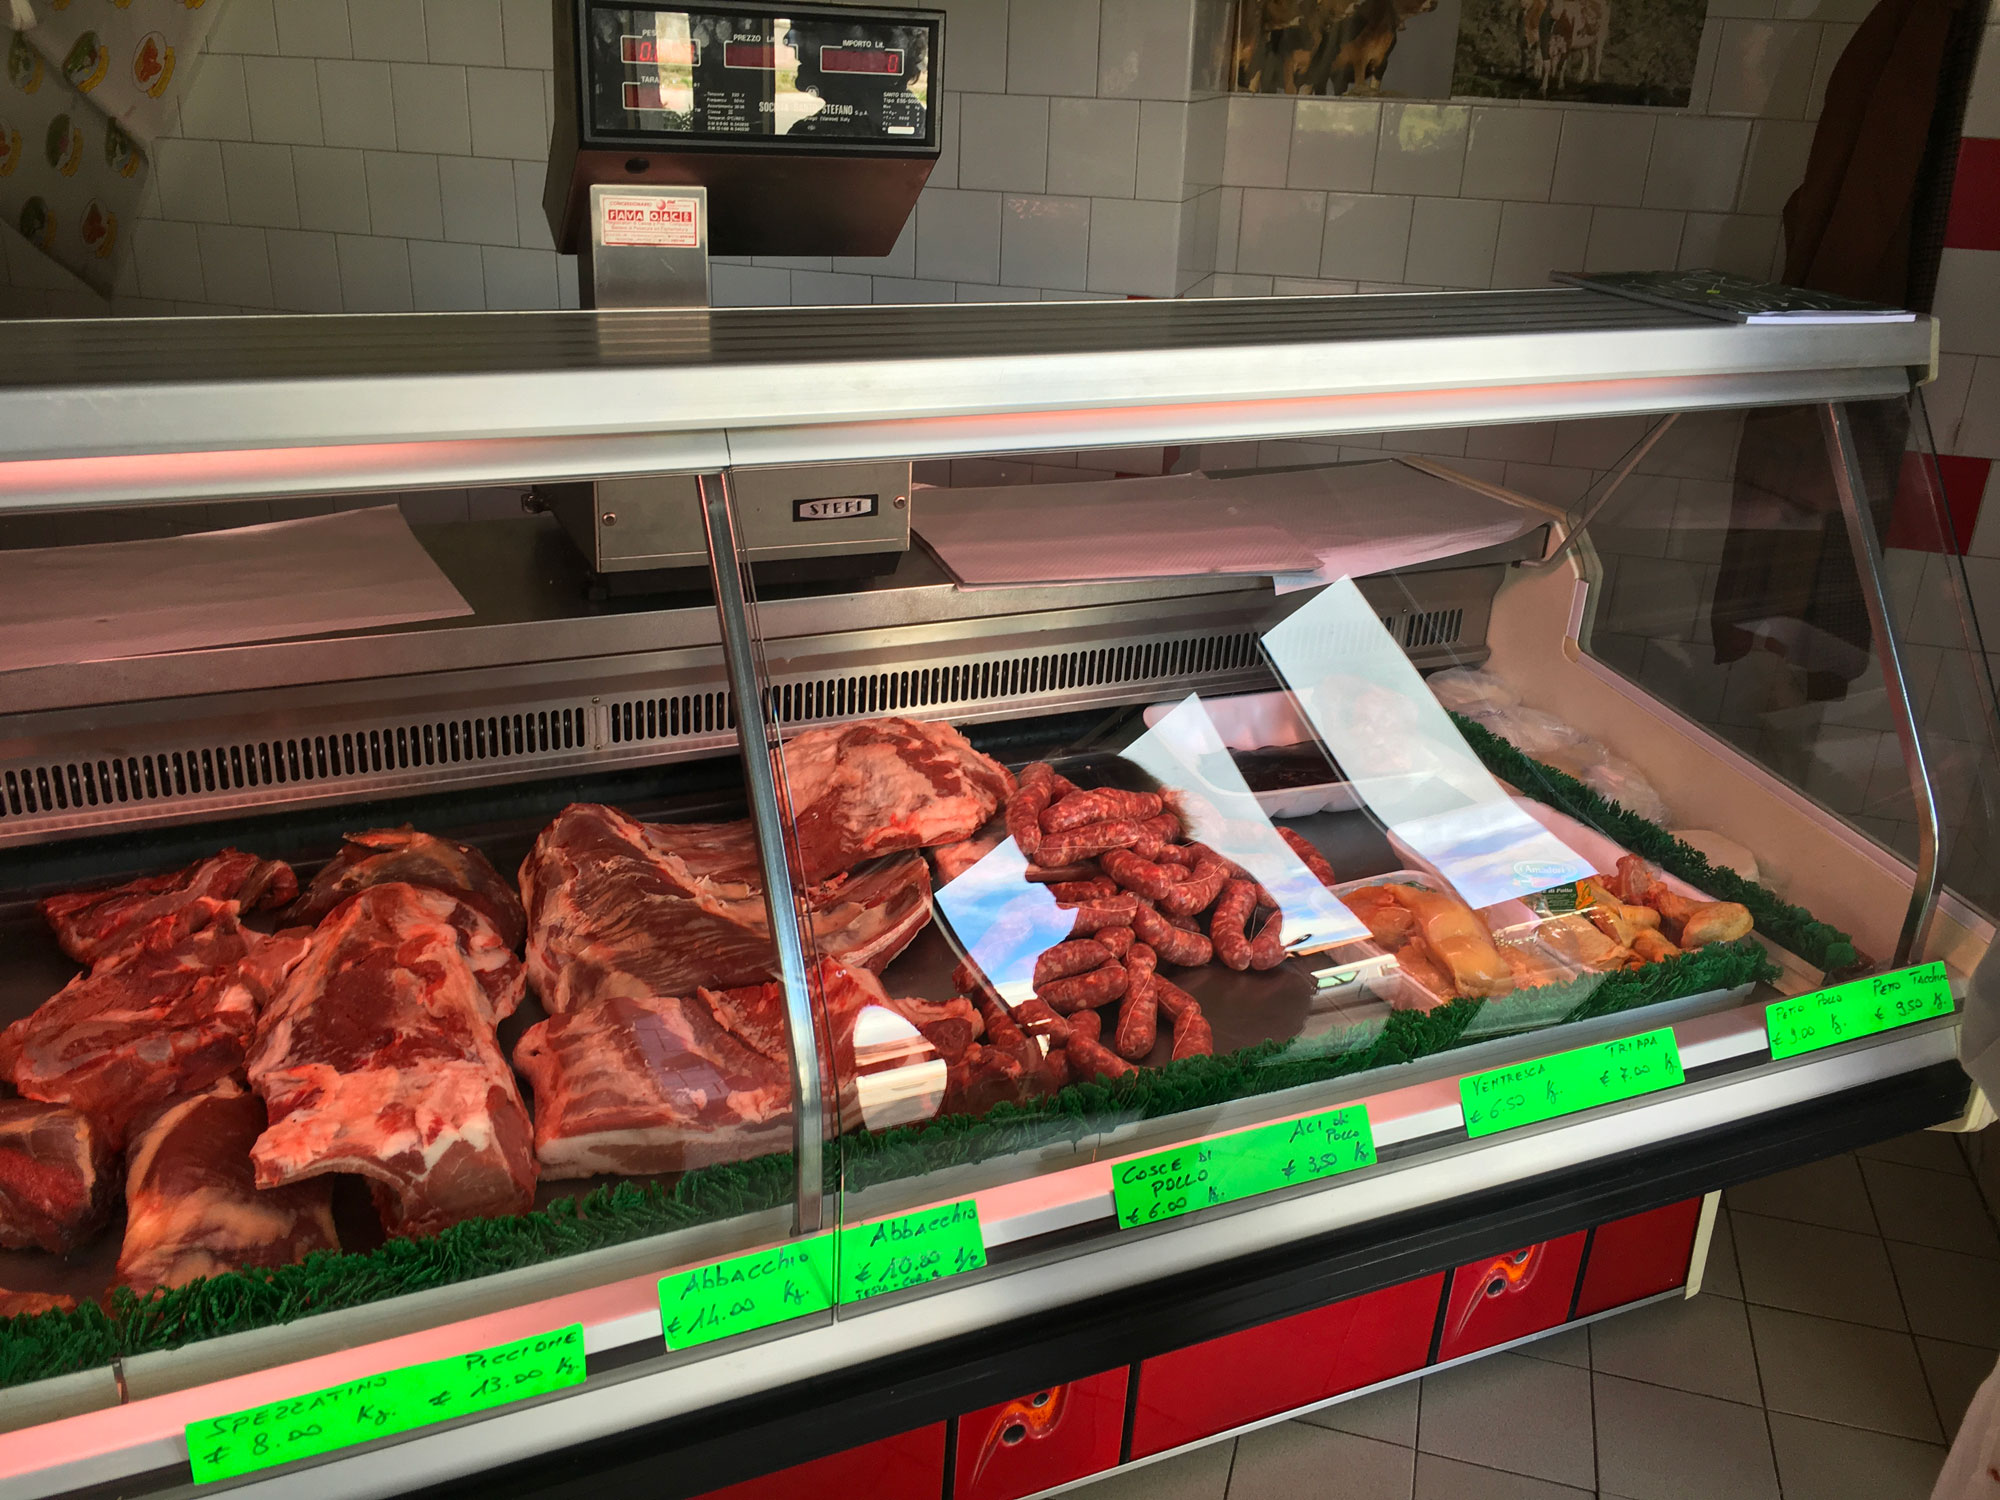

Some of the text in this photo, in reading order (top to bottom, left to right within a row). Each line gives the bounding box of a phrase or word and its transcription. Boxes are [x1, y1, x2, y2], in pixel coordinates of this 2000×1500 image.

[733, 34, 762, 42] PREZZO
[842, 39, 872, 48] IMPORTO
[887, 53, 899, 73] 0
[641, 75, 660, 84] TARA
[821, 104, 853, 116] STEFANO
[608, 209, 644, 221] FAVA
[1605, 1036, 1658, 1057] TRIPPA
[1472, 1063, 1546, 1096] VENTRESCA
[1599, 1070, 1610, 1087] €
[1621, 1065, 1651, 1082] 7.00
[1470, 1110, 1484, 1124] €
[1489, 1094, 1526, 1119] 6.50
[1122, 1158, 1182, 1184] COSCE
[1151, 1169, 1209, 1198] POLLO
[870, 1202, 977, 1247] Abbacchio
[1125, 1208, 1139, 1224] €
[1149, 1197, 1187, 1218] 6.00
[680, 1246, 809, 1300] Abbacchio
[855, 1262, 872, 1282] €
[879, 1250, 941, 1282] 10.00
[667, 1316, 683, 1338] €
[687, 1299, 755, 1334] 14.00
[464, 1331, 577, 1371] PICCIONE
[470, 1369, 544, 1398] 13.00
[252, 1423, 323, 1456] 8.00
